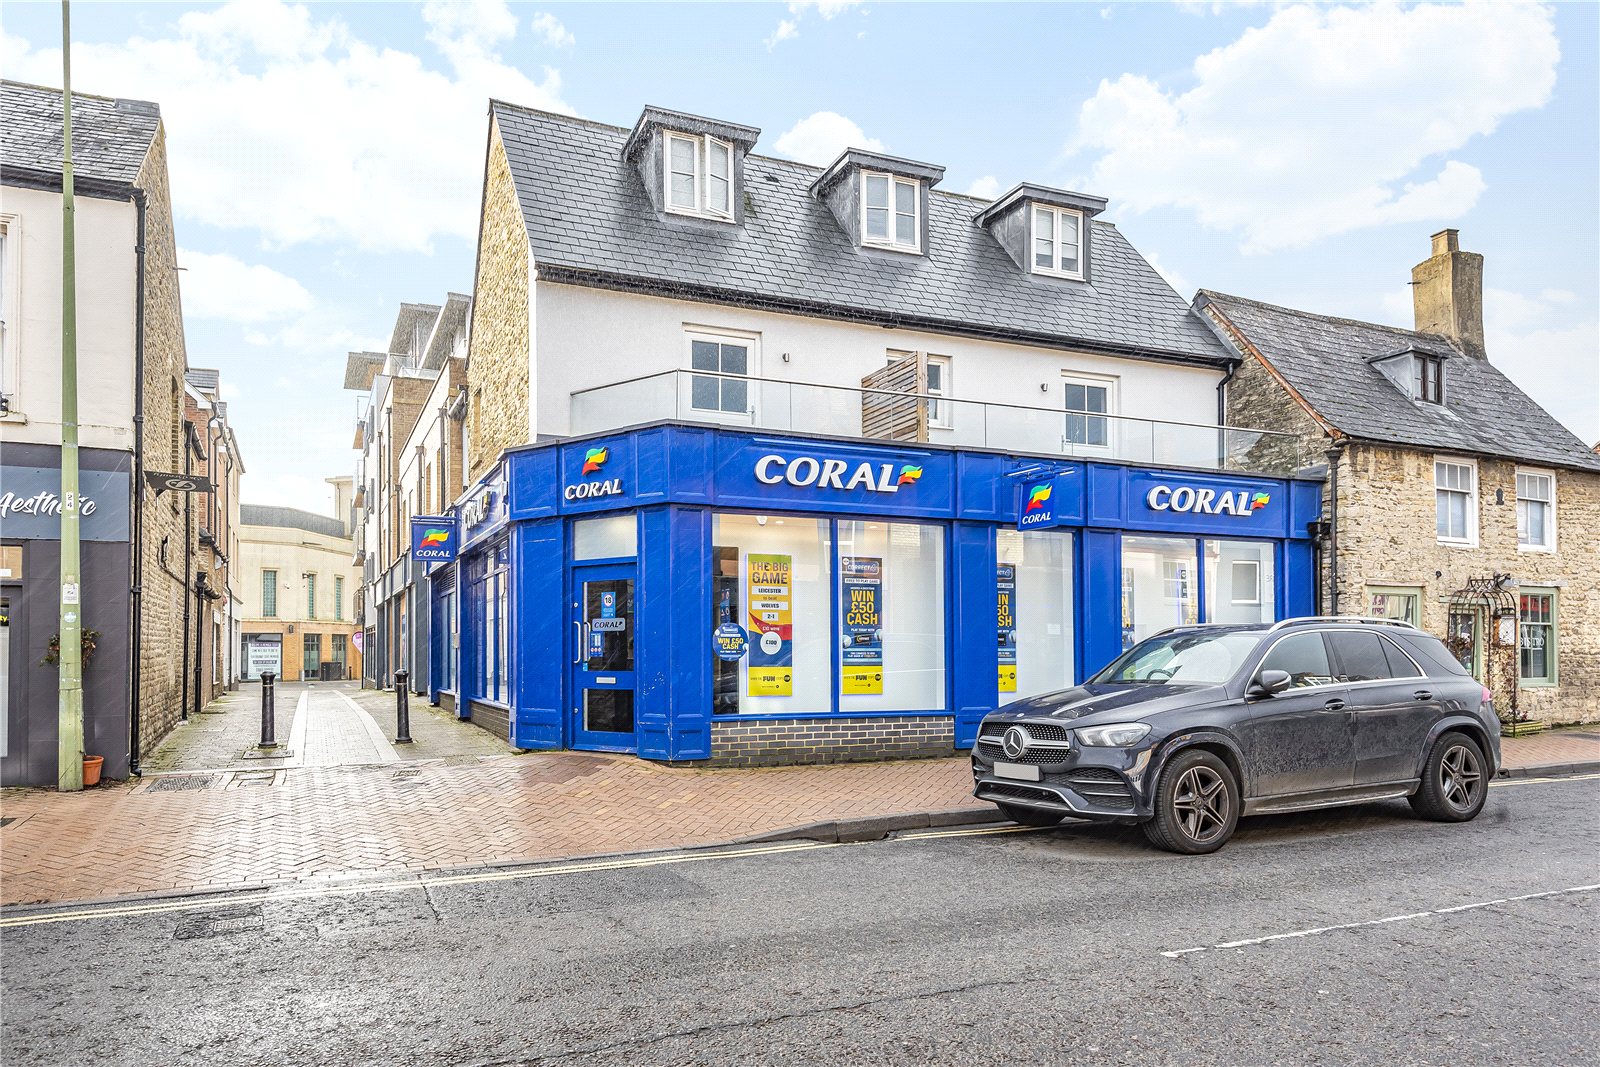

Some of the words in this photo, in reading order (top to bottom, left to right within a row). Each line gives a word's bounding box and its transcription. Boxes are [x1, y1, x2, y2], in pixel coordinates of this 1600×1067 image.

[754, 454, 899, 493] CORAL
[564, 478, 622, 500] CORAL
[0, 490, 97, 518] Aesthc
[1146, 485, 1253, 517] CORAL
[1022, 511, 1052, 525] CORAL
[416, 549, 451, 557] CORAL
[751, 561, 770, 571] THE
[772, 562, 789, 572] BIG
[752, 572, 788, 584] GAME
[851, 590, 874, 601] WIN
[998, 594, 1009, 605] IN
[851, 602, 875, 613] £50
[997, 604, 1009, 616] 50
[847, 613, 878, 625] CASH
[997, 615, 1013, 627] SH
